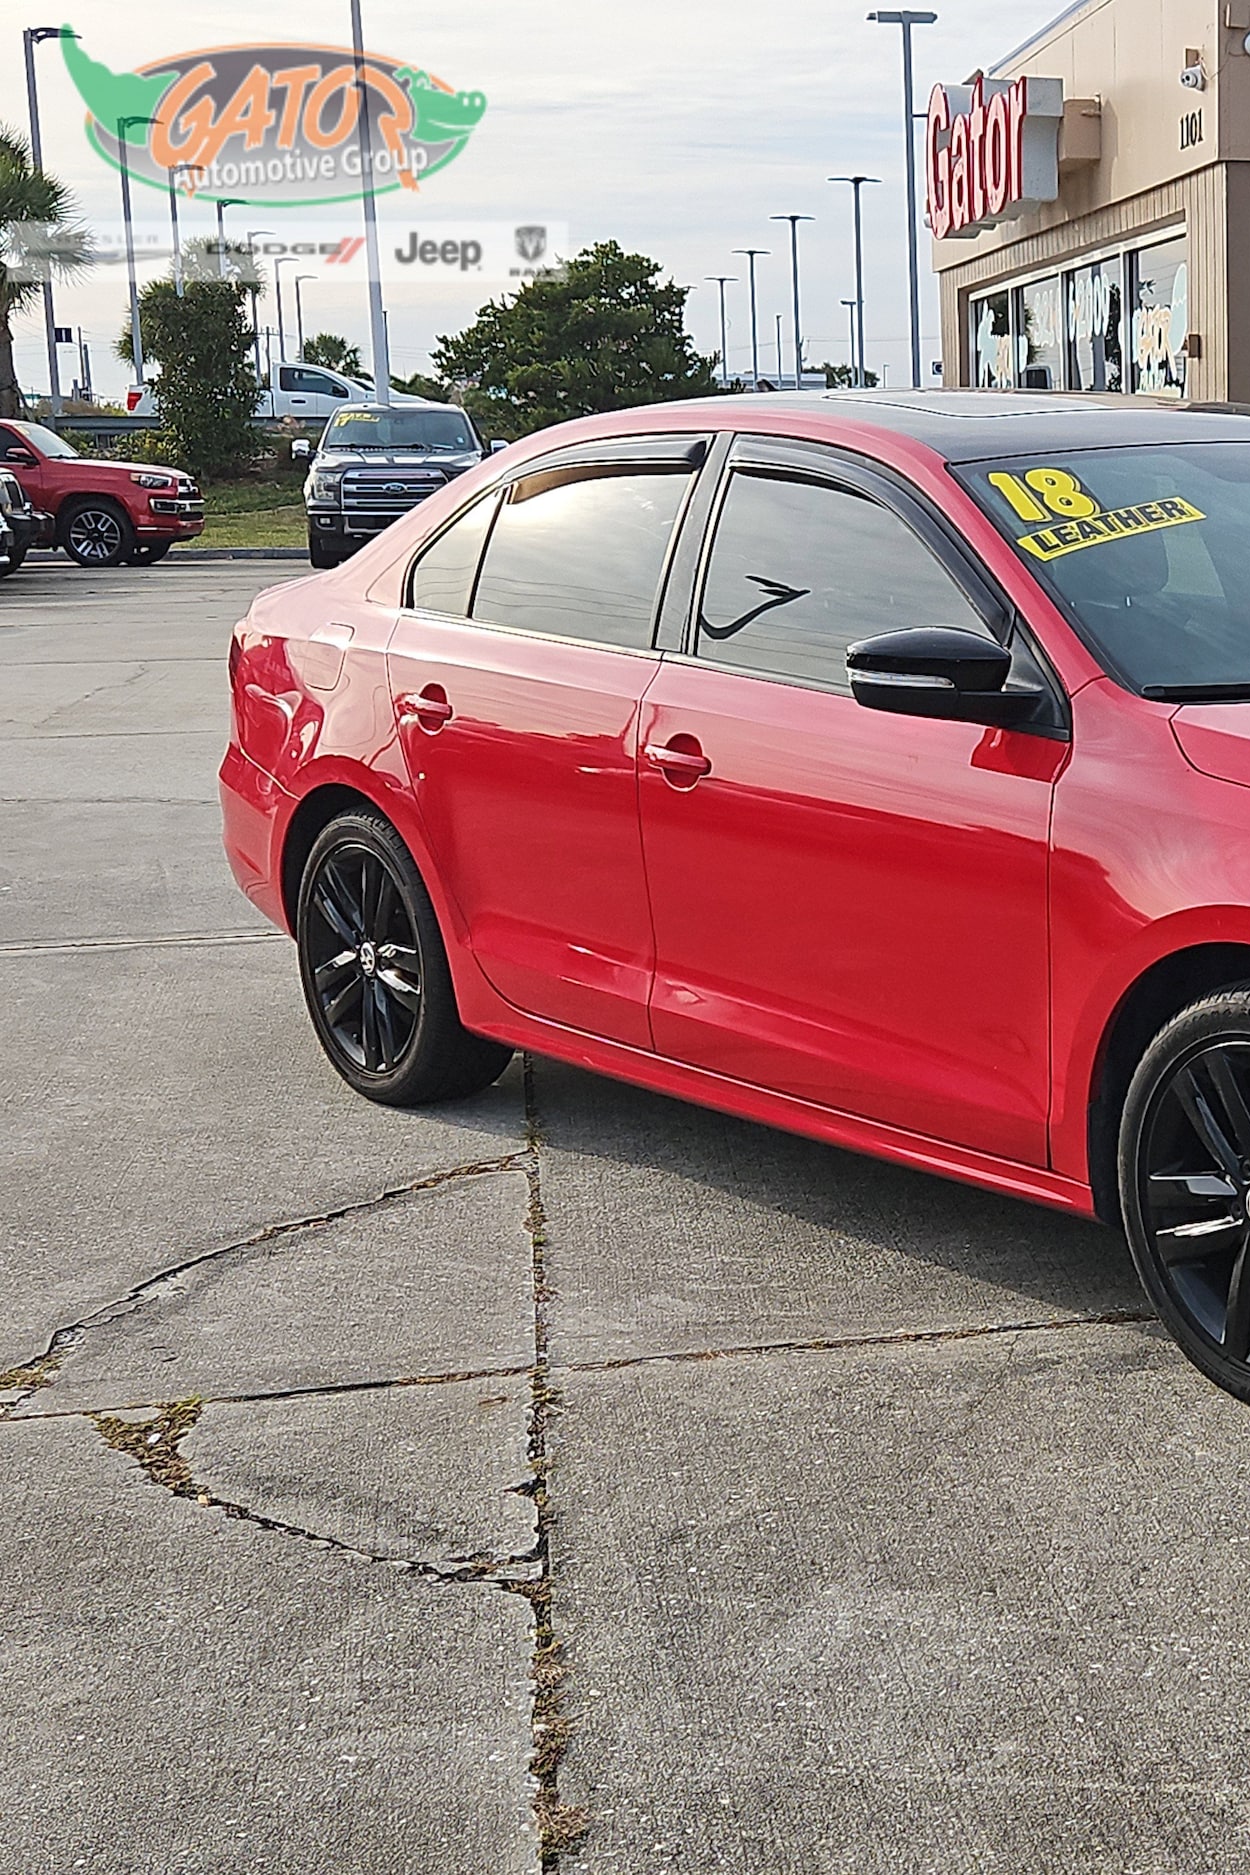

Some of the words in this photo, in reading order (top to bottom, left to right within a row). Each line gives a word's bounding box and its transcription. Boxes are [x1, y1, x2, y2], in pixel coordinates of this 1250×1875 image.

[1180, 107, 1204, 150] 1101
[926, 75, 1028, 240] Gator
[988, 467, 1102, 522] 18
[1030, 499, 1191, 553] LEATHER
